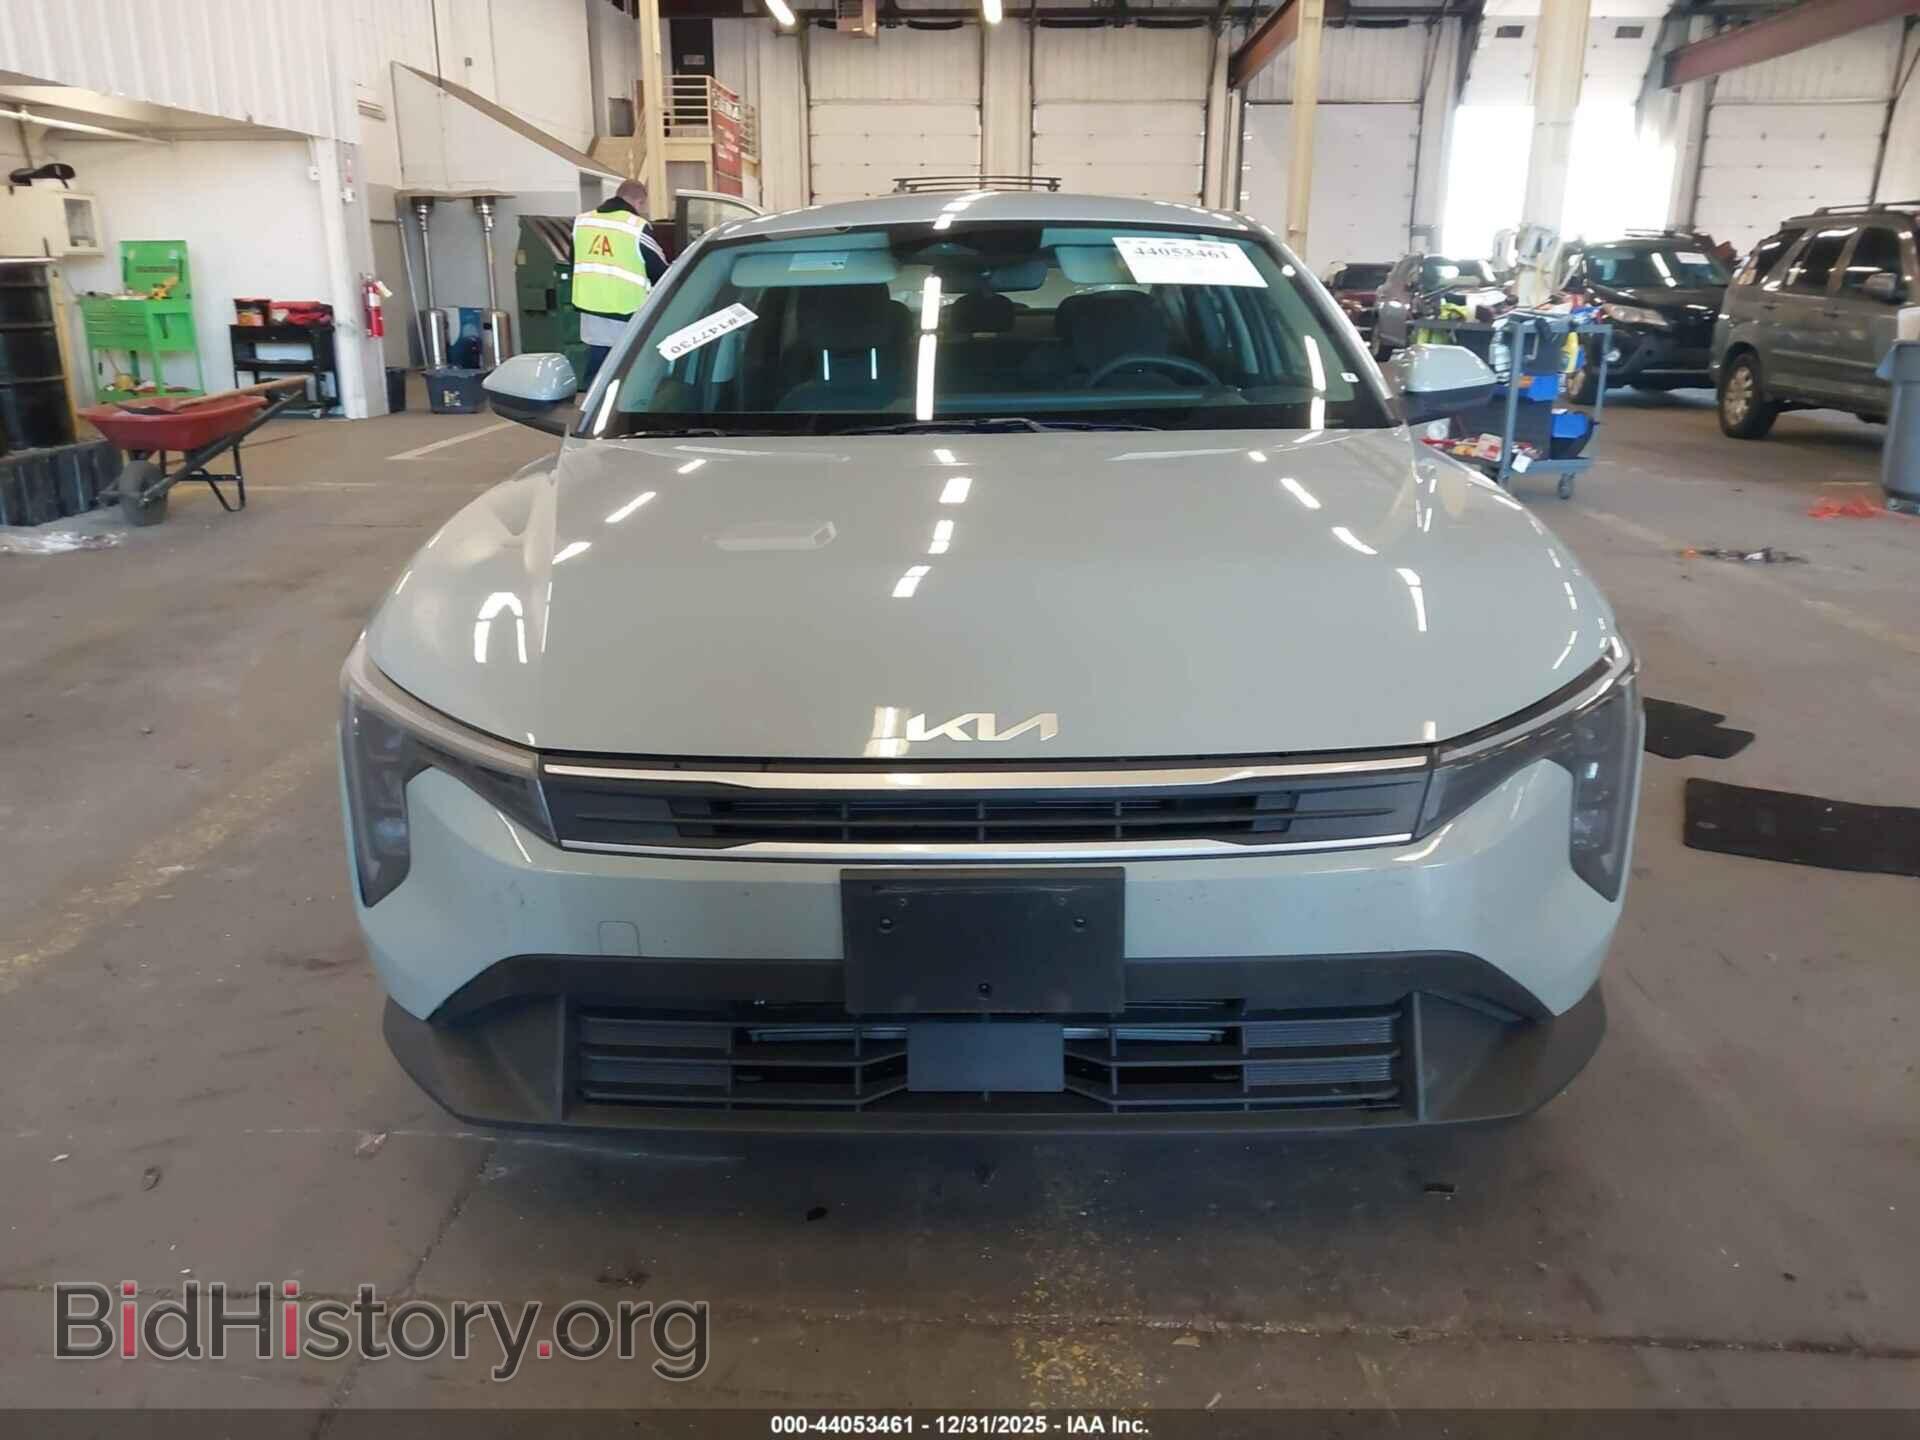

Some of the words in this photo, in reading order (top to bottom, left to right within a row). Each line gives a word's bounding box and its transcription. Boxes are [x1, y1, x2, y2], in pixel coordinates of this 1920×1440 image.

[1134, 246, 1232, 260] 44053461
[670, 317, 738, 354] #147730
[906, 712, 1057, 742] KIA
